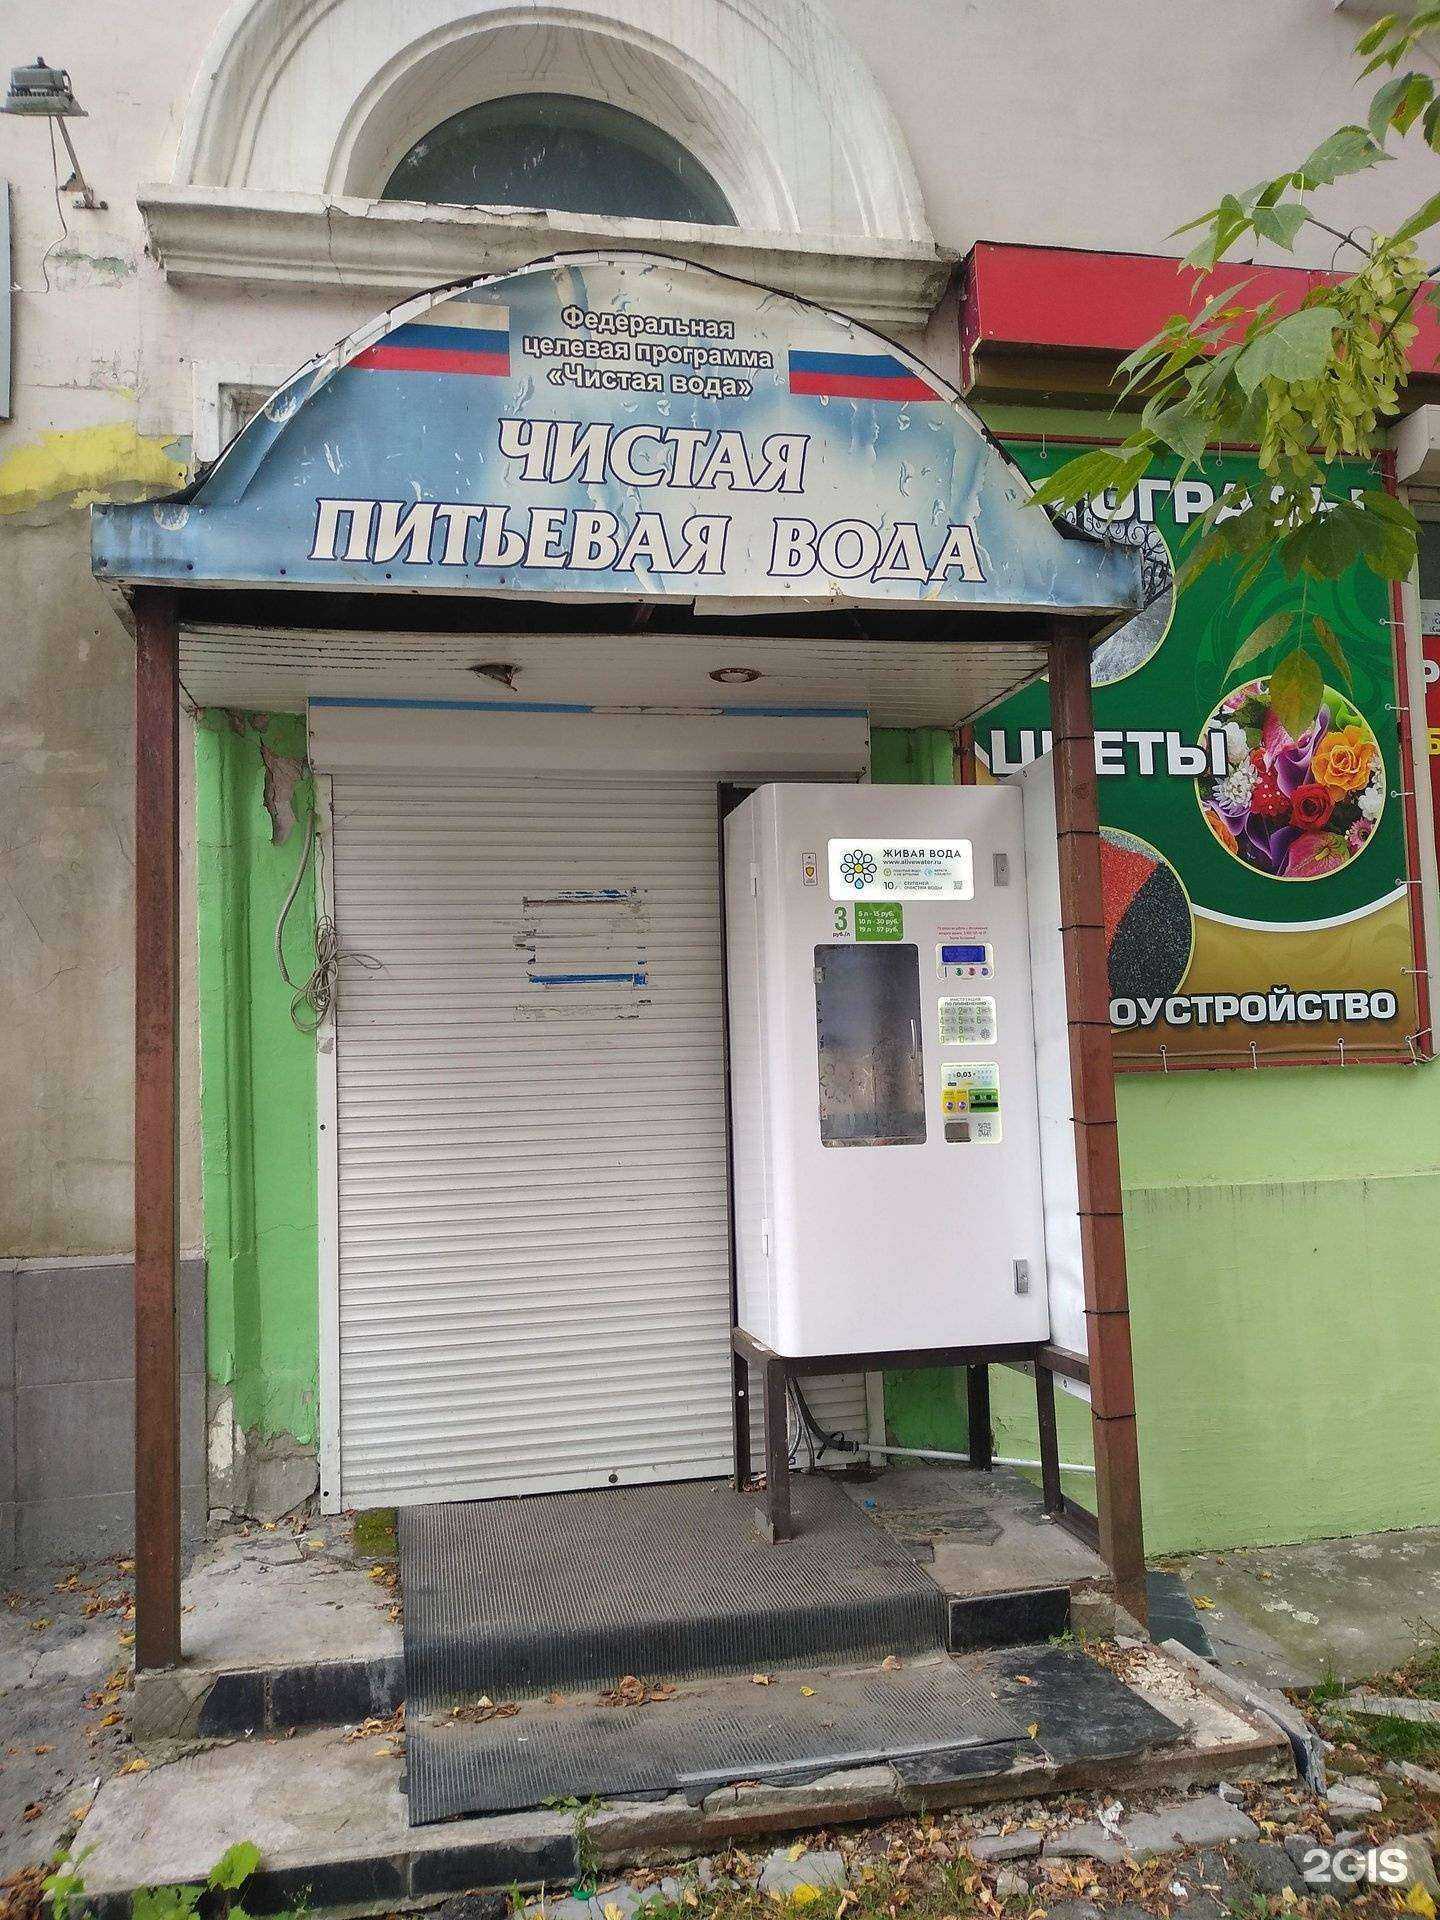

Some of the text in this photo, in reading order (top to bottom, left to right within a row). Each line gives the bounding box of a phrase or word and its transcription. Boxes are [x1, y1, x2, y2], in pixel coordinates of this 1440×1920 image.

[561, 305, 735, 339] Федеральная
[523, 336, 774, 369] целевая программа
[546, 363, 753, 398] «Чистая вода»
[498, 417, 810, 493] ЧИСТАЯ
[308, 498, 987, 583] ПИТЬЕВАЯ ВОДА
[883, 849, 961, 858] ЖИВАЯ ВОДА
[834, 906, 848, 931] 3
